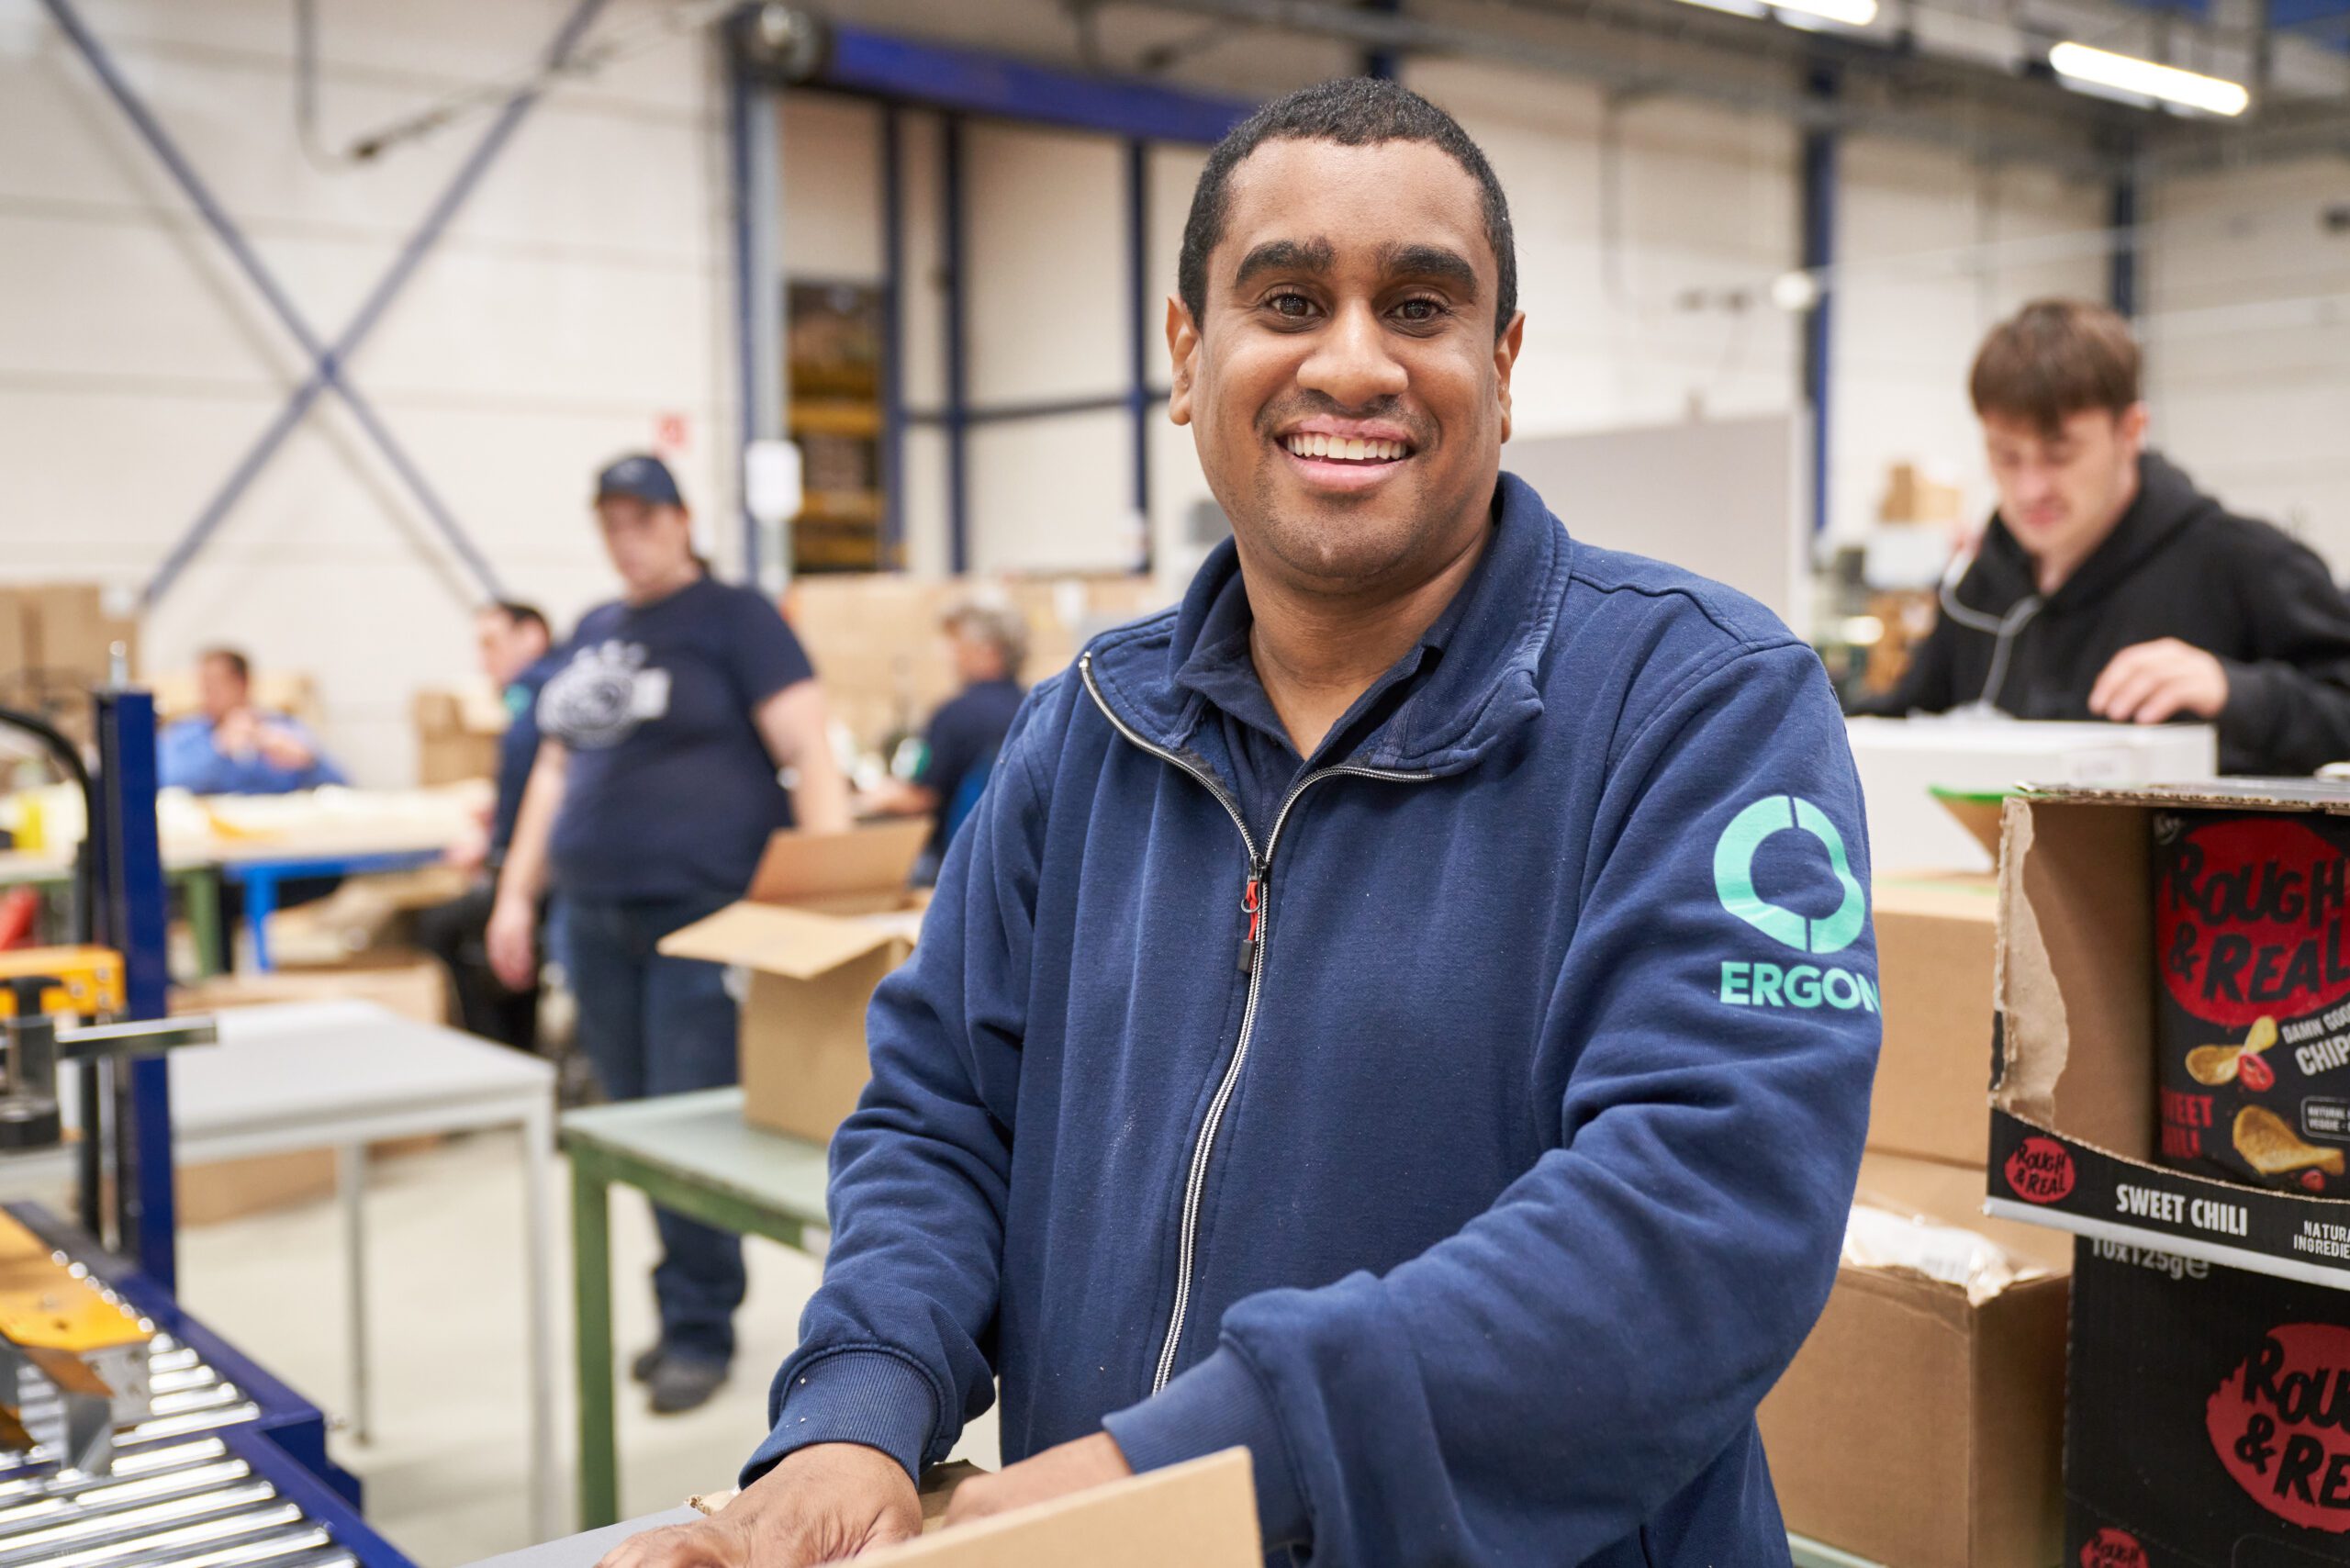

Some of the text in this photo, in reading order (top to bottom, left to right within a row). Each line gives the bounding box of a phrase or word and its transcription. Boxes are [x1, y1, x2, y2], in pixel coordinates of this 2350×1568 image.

[2168, 842, 2344, 929] ROUGH
[2169, 918, 2350, 1003] & REAL
[1720, 961, 1882, 1014] ERGON
[2281, 1017, 2324, 1045] DAMN
[2295, 1032, 2350, 1076] CHIP
[2013, 1168, 2065, 1195] & REAL
[2016, 1144, 2065, 1174] ROUGH
[2116, 1184, 2248, 1237] SWEET CHILI
[2234, 1414, 2276, 1474] &
